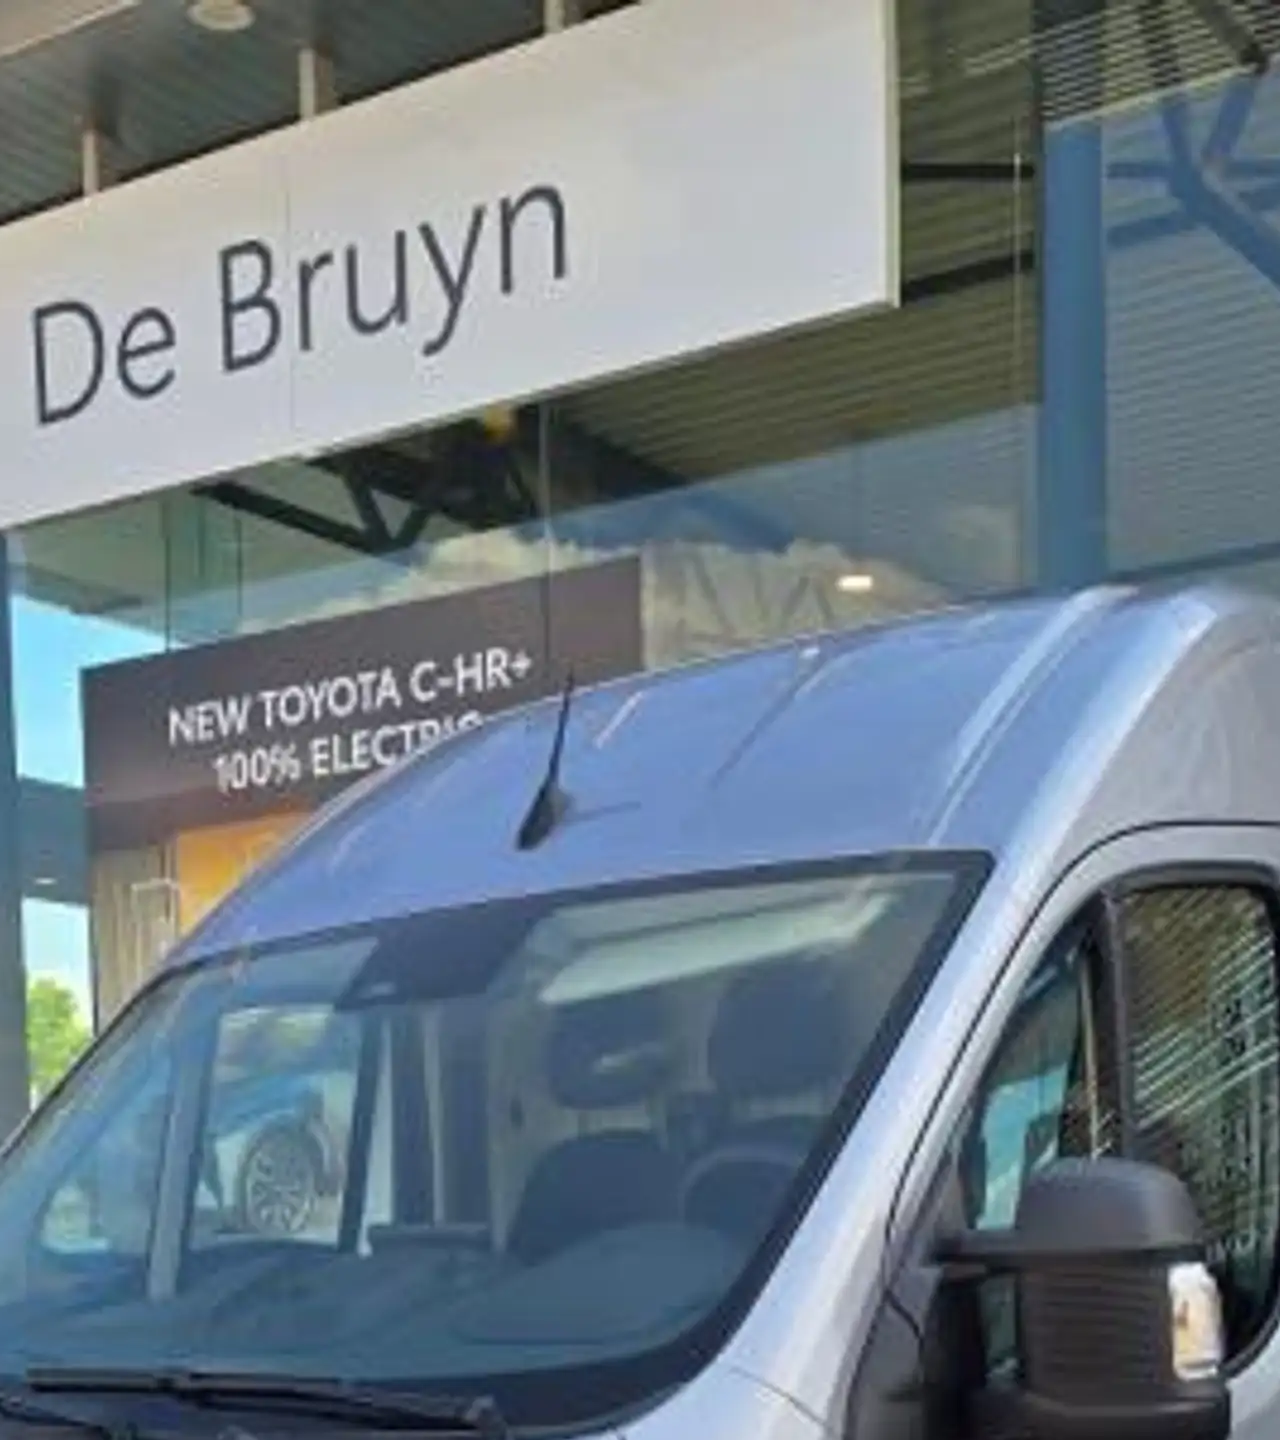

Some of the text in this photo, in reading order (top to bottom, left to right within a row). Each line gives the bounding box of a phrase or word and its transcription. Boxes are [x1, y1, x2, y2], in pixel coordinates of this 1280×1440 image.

[29, 181, 569, 427] De Bruyn
[168, 646, 532, 747] NEW TOYOTA C-HR+
[214, 740, 302, 794] 100%
